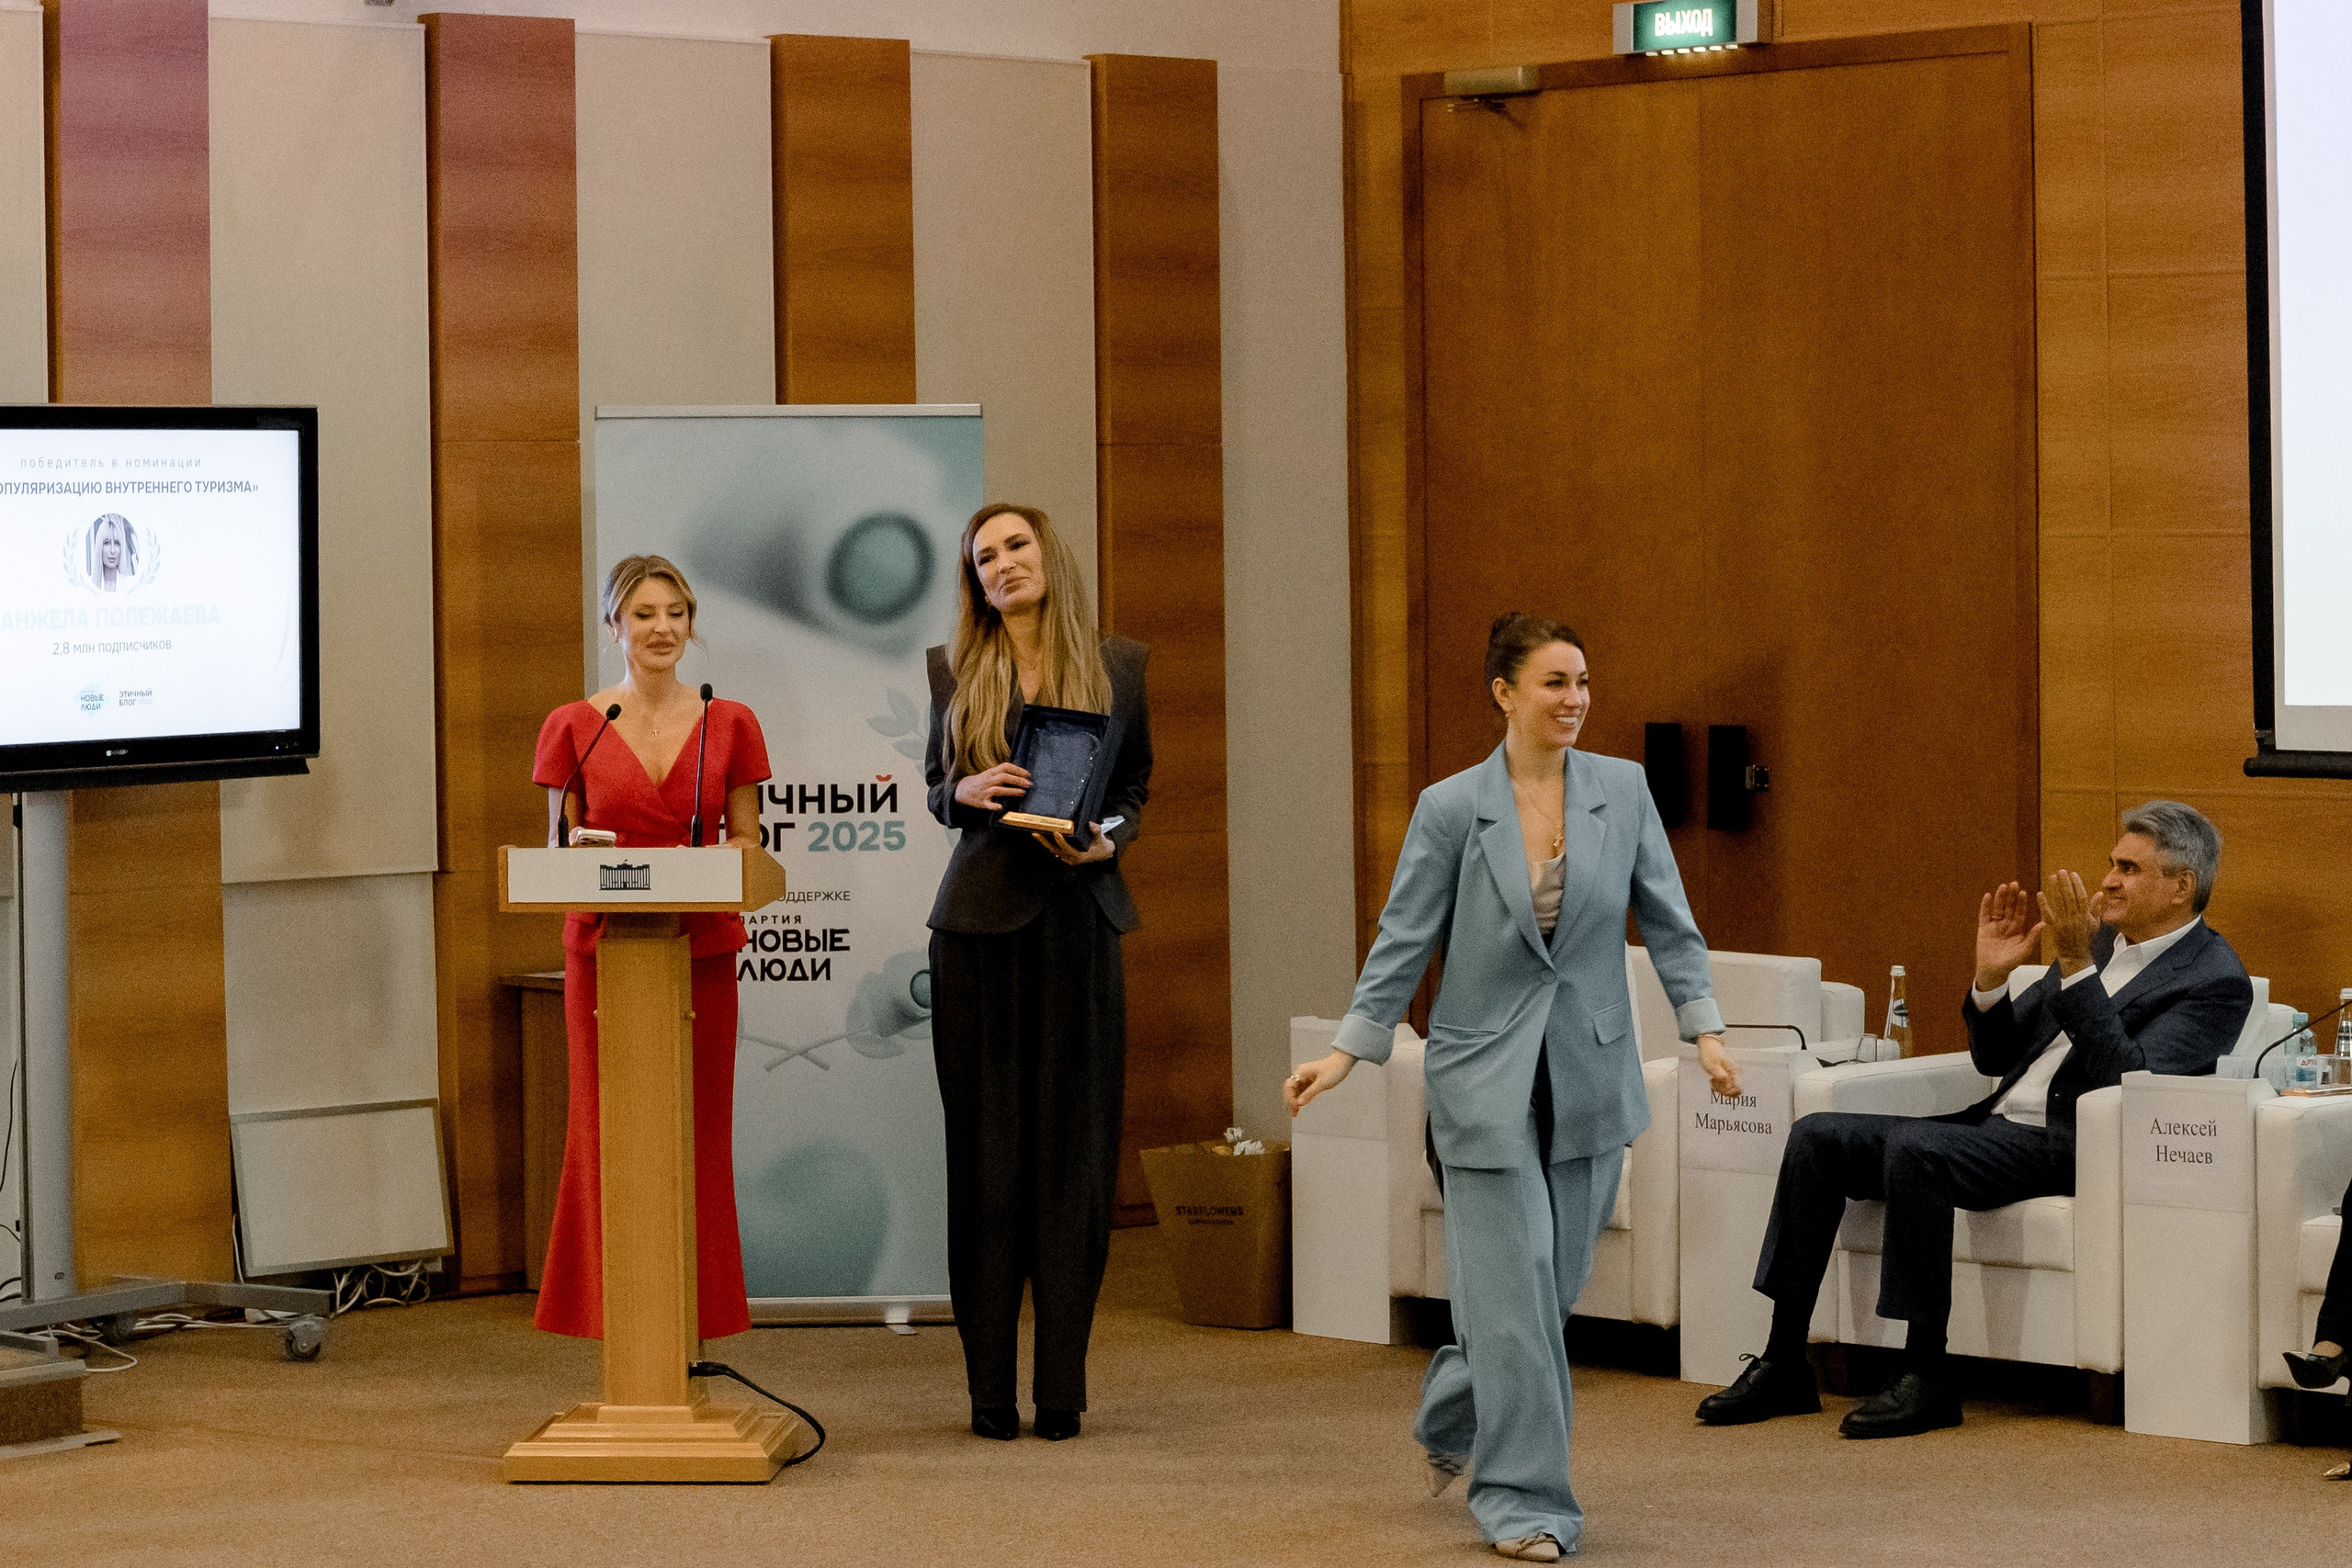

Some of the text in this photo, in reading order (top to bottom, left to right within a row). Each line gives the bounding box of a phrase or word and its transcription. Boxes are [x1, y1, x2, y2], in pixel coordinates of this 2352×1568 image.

[1655, 8, 1713, 37] ВЫХОД
[20, 457, 201, 469] победитель в номинации
[105, 480, 193, 494] ВНУТРЕННЕГО
[195, 480, 259, 493] ТУРИЗМА»
[1, 604, 220, 631] АНЖЕЛА ПОЛЕЖАЕВА
[52, 640, 172, 656] 2,8 млн подписчиков
[119, 688, 153, 698] ЭТИЧНЫЙ
[758, 774, 898, 814] ЧНЫЙ
[808, 820, 906, 852] 2025
[777, 890, 851, 904] ДДЕРЖКЕ
[738, 928, 851, 953] НОВЫЕ
[737, 958, 831, 981] ЛЮДИ
[1710, 1088, 1757, 1111] Мария
[1695, 1112, 1772, 1134] Марьясова
[2150, 1118, 2217, 1136] Алексей
[2156, 1145, 2213, 1165] Нечаев
